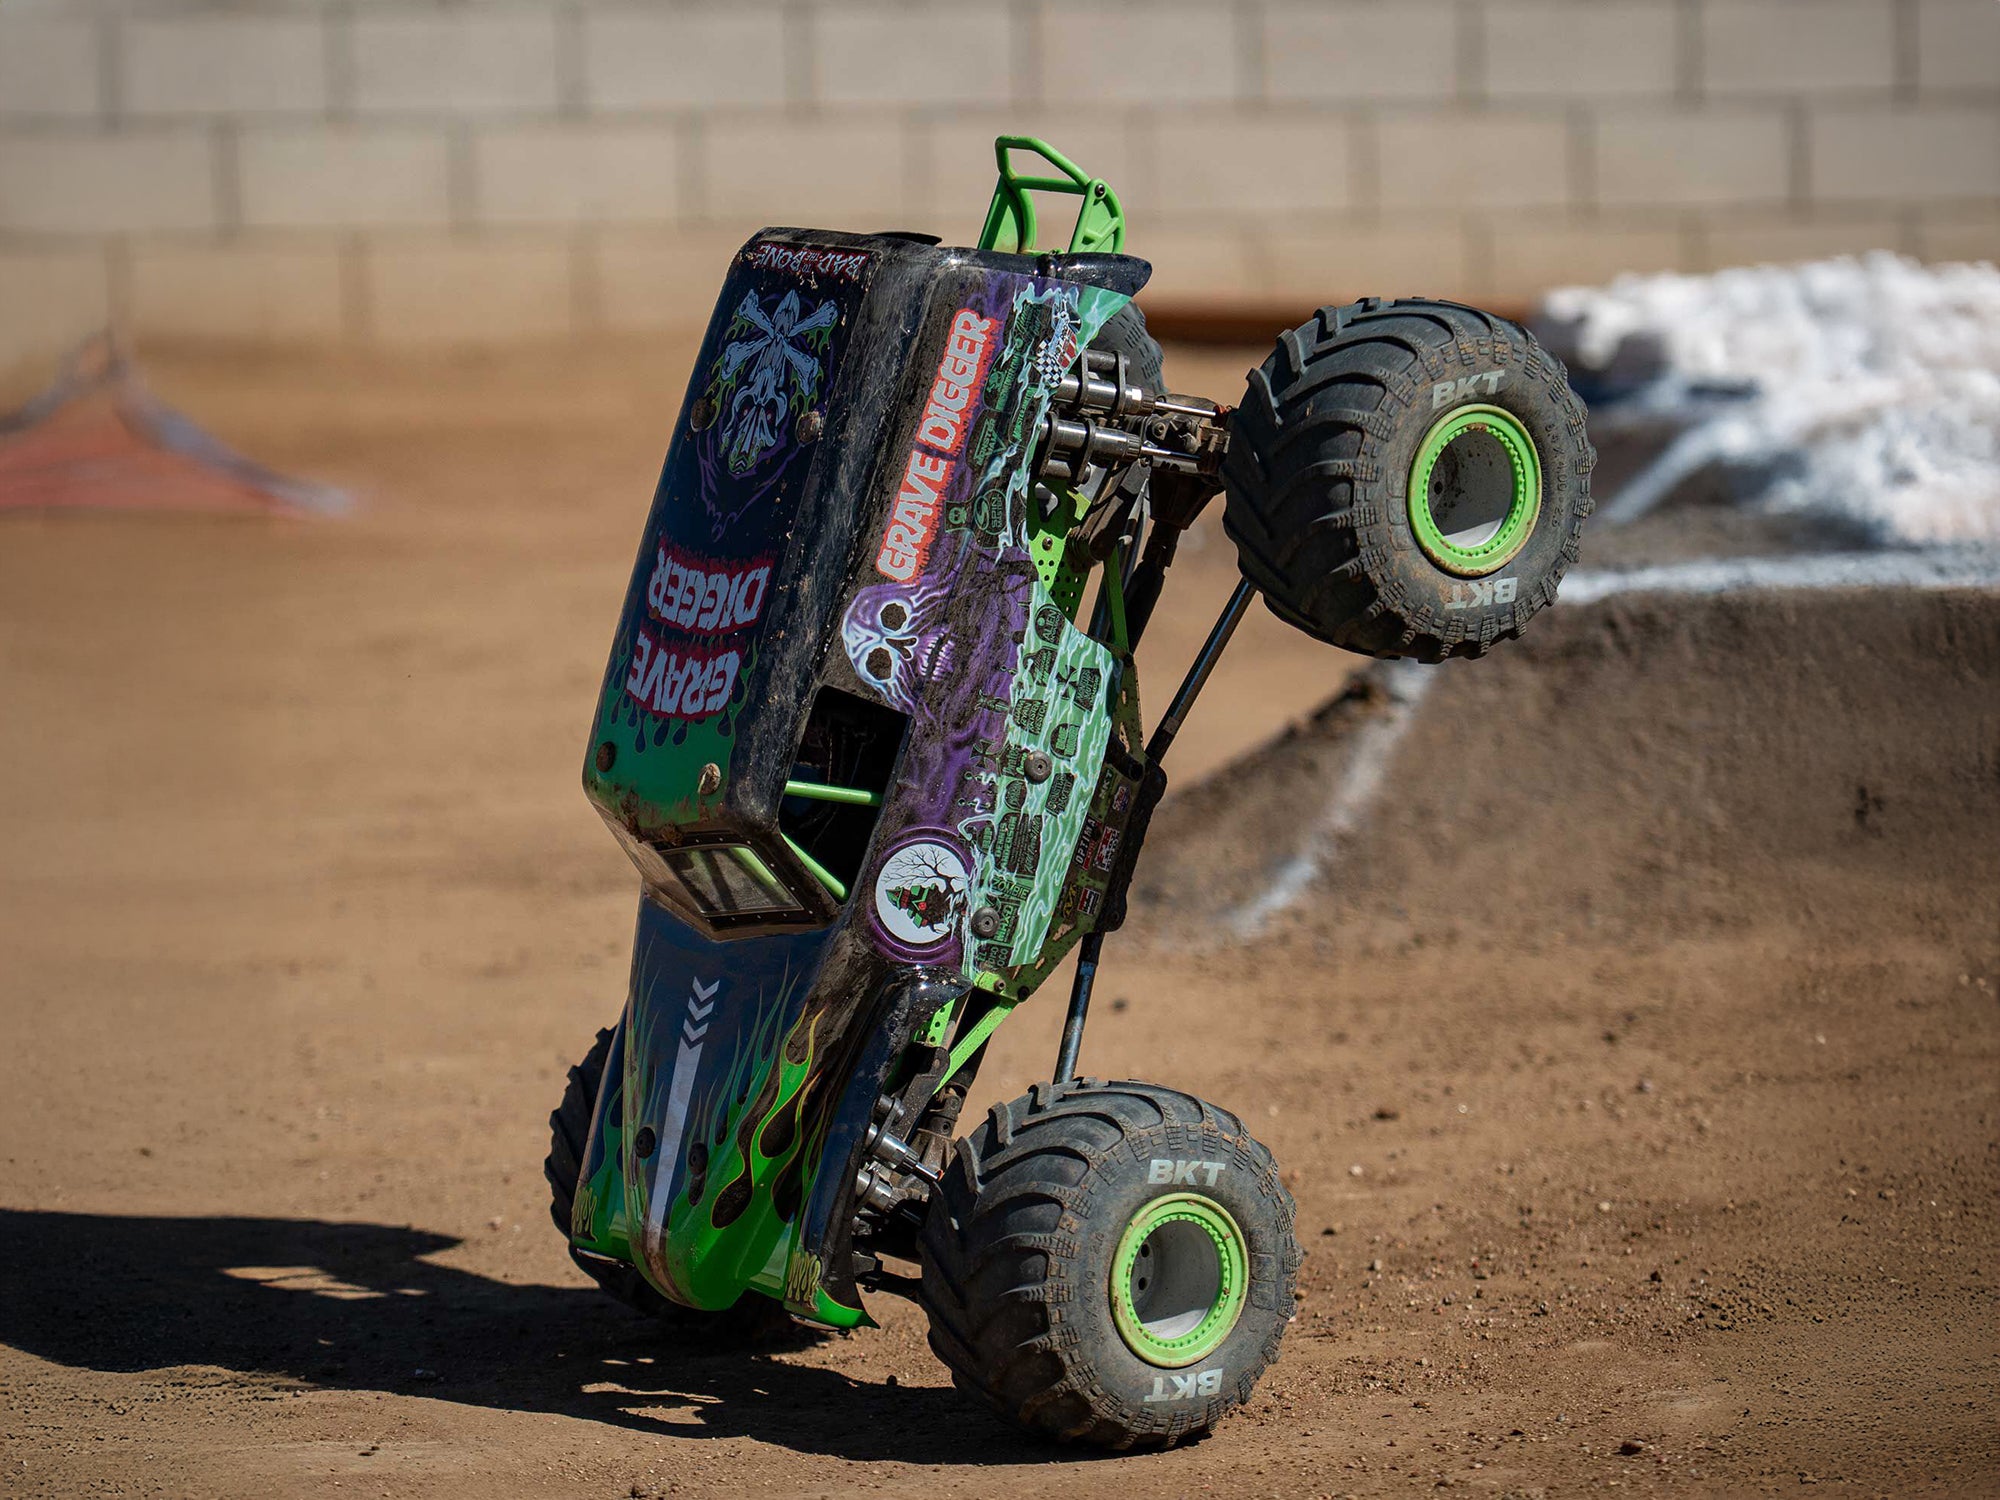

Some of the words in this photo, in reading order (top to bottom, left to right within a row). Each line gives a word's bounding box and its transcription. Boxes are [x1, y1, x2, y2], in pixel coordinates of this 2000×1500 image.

[755, 245, 806, 271] BONE
[817, 253, 865, 276] BAD
[1431, 370, 1505, 409] BKT
[877, 451, 947, 580] GRAVE
[919, 310, 991, 449] DIGGER
[975, 417, 995, 466] MONSTER
[649, 547, 770, 630] DIGGER
[1444, 577, 1518, 609] BKT
[1042, 609, 1057, 640] ALIEN
[626, 630, 740, 714] GRAVE
[1019, 701, 1032, 725] RYAN
[993, 821, 1007, 857] DENNIS
[999, 815, 1017, 869] ANDERSON
[1074, 818, 1095, 863] OPTIMA
[1148, 1159, 1226, 1187] BKT
[1144, 1368, 1223, 1402] BKT
